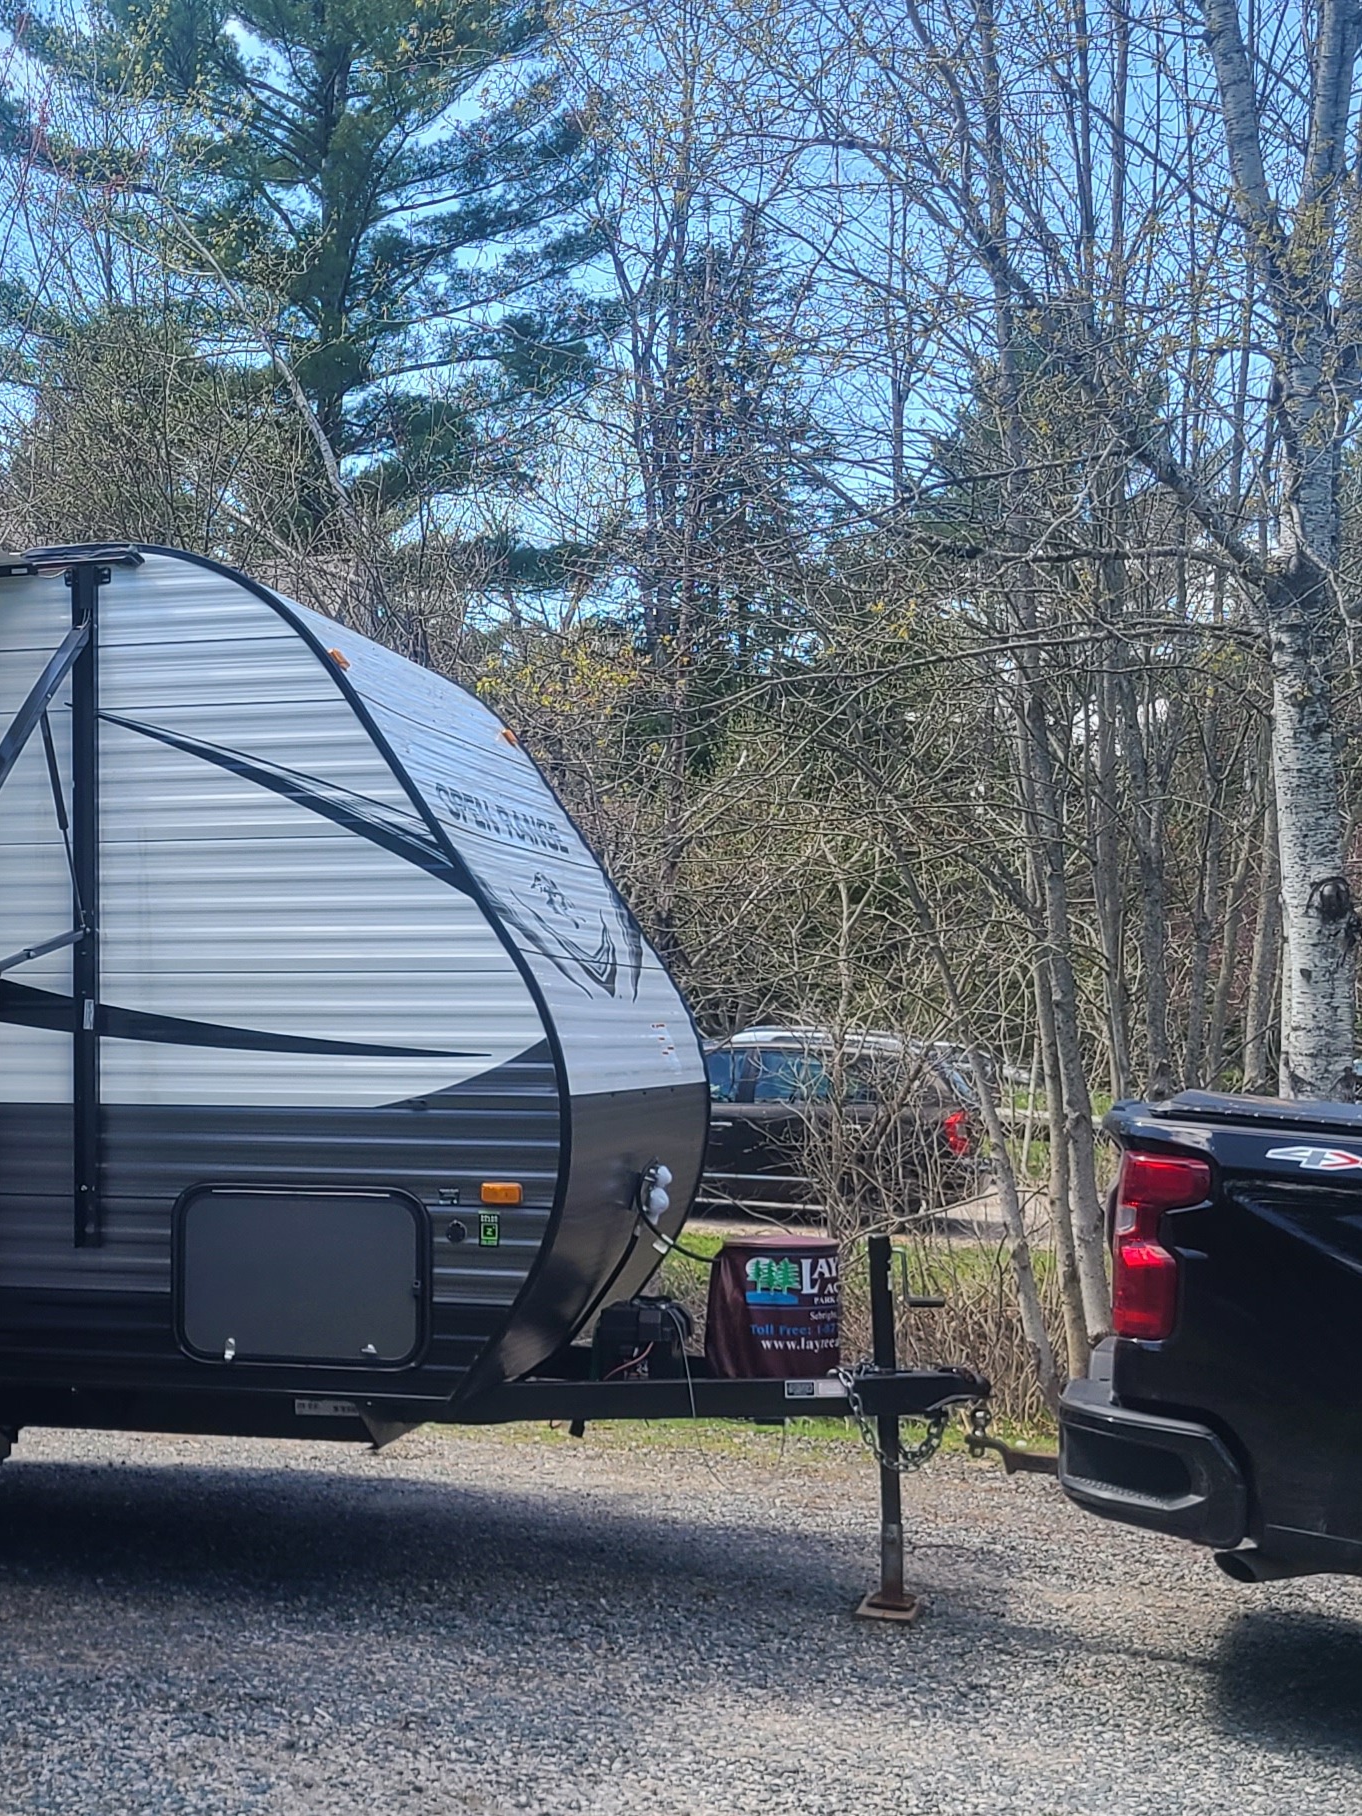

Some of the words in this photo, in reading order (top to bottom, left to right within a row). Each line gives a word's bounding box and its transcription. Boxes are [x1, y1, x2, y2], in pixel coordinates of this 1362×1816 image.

[436, 782, 500, 835] OPEN
[495, 804, 569, 854] RANGE
[750, 1323, 774, 1336] Toll
[779, 1324, 811, 1336] Free:
